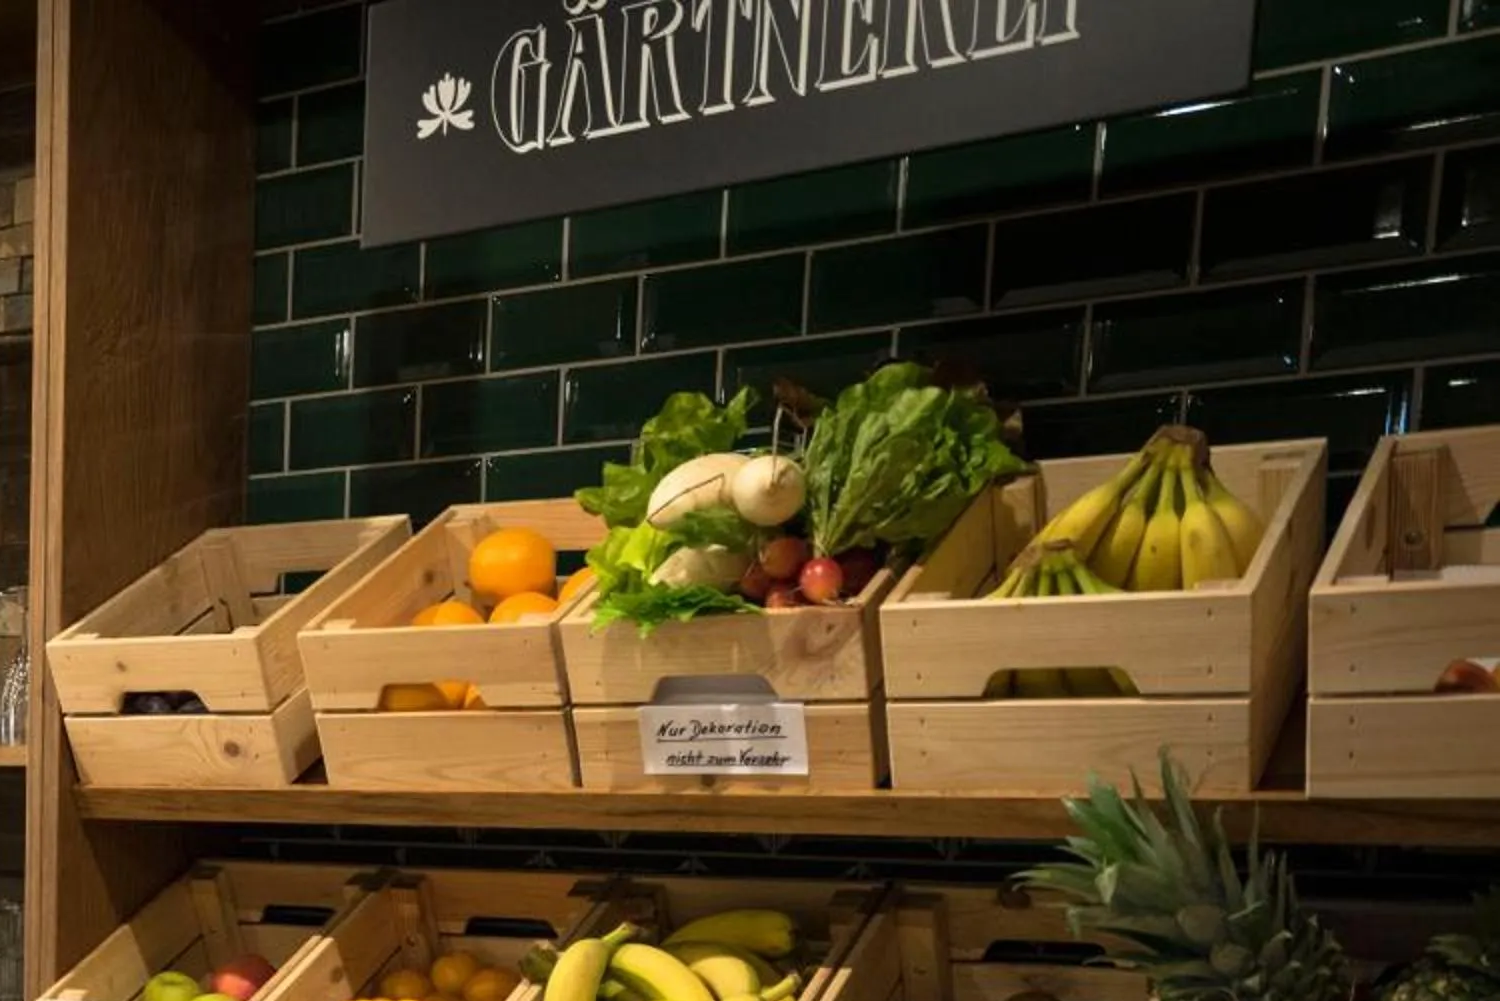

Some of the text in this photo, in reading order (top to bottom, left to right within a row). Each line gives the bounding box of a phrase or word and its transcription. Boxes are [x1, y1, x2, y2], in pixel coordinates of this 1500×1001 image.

[657, 719, 782, 741] Nur Dekoration
[666, 749, 703, 767] nicht
[706, 754, 736, 767] zum
